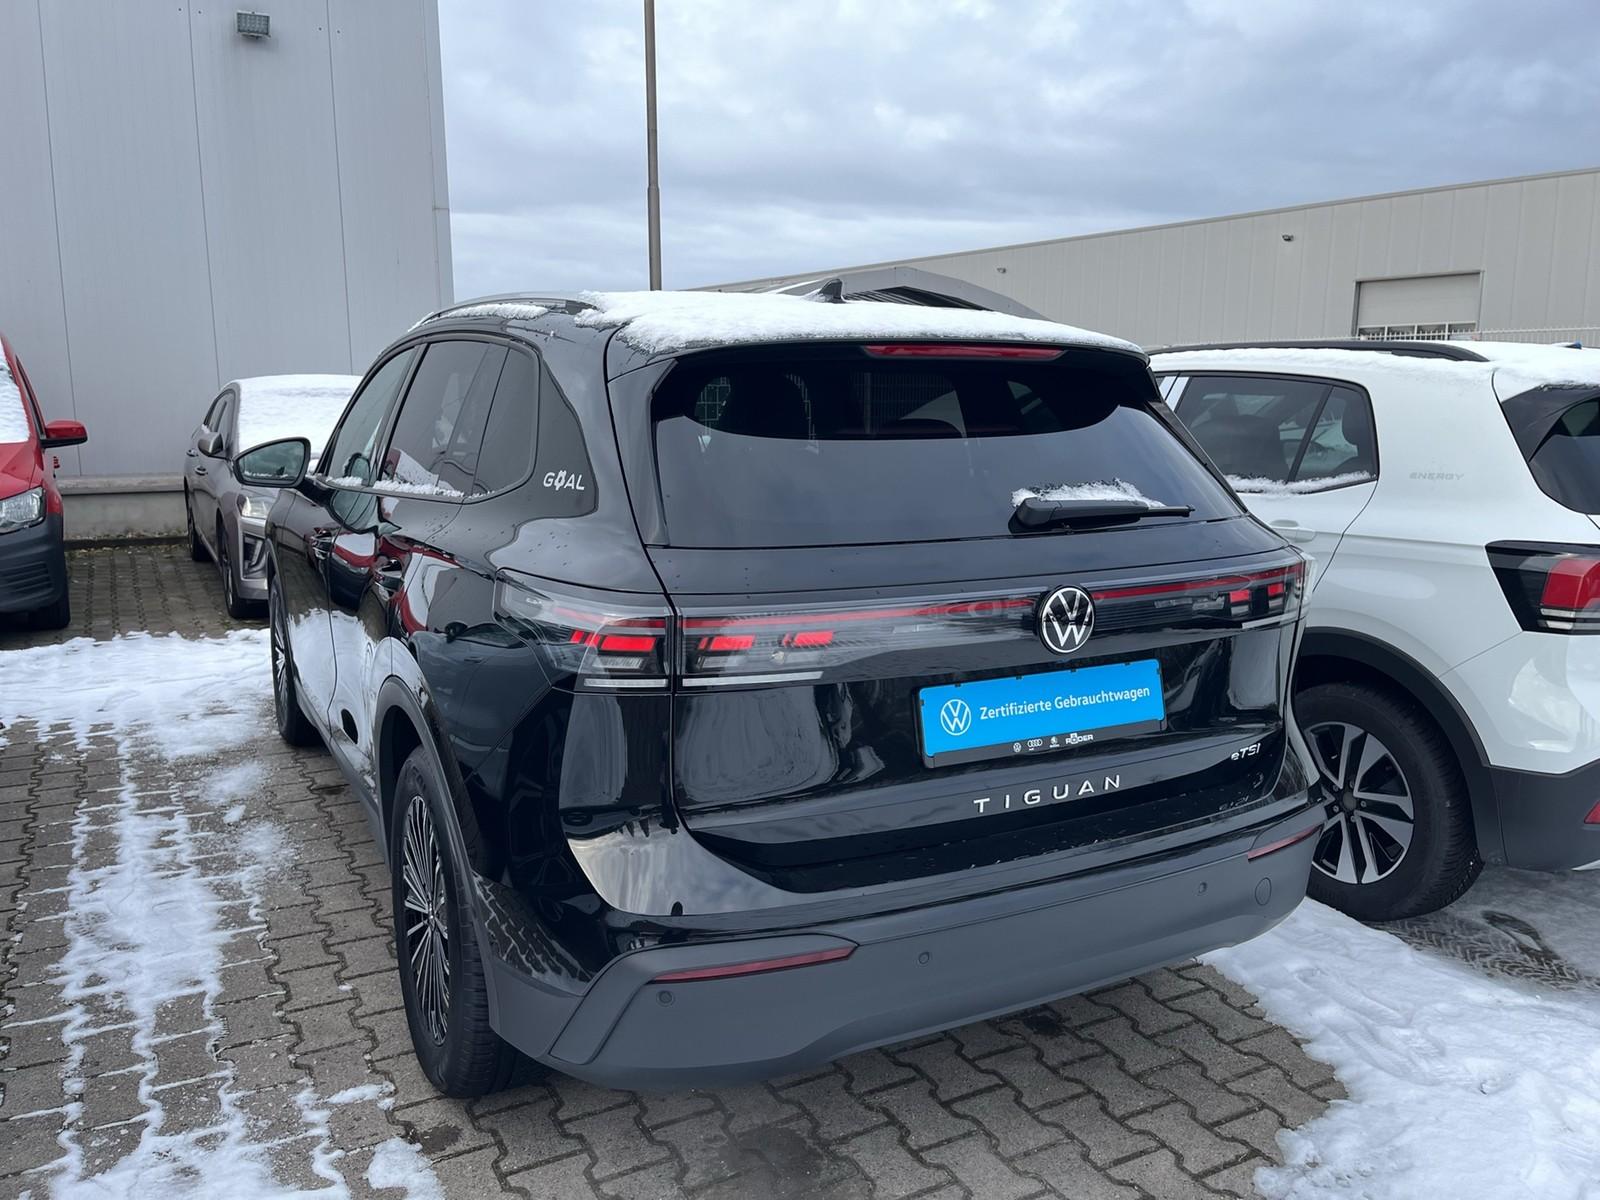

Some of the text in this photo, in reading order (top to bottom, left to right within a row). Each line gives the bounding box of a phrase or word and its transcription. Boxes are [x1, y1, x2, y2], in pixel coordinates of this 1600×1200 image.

[543, 470, 585, 491] GOAL
[1409, 472, 1465, 481] ENERGY
[979, 686, 1151, 720] Zertifizierte Gebrauchtwagen
[1231, 743, 1262, 761] eTSI
[973, 775, 1121, 813] TIGUAN
